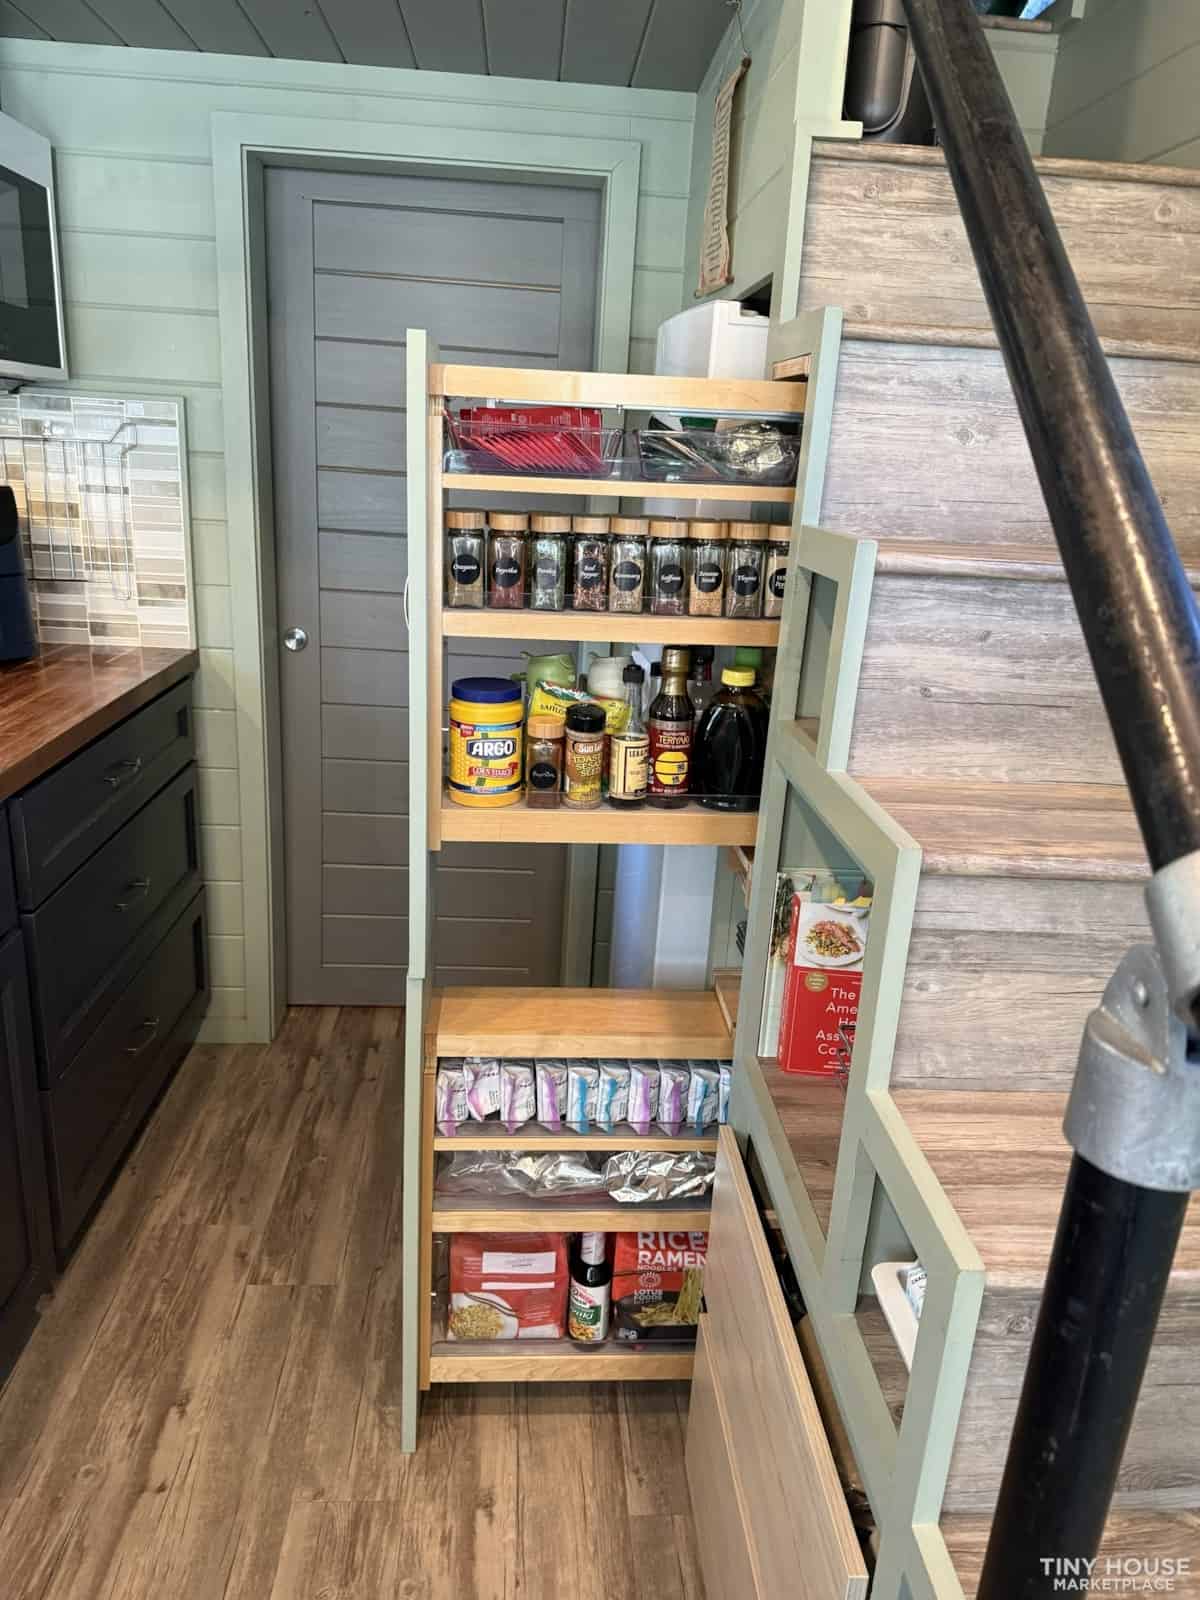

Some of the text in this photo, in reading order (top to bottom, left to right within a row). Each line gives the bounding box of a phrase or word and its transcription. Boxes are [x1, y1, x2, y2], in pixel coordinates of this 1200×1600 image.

[471, 739, 514, 757] ARGO
[831, 987, 856, 1000] The
[637, 1231, 706, 1251] RICE
